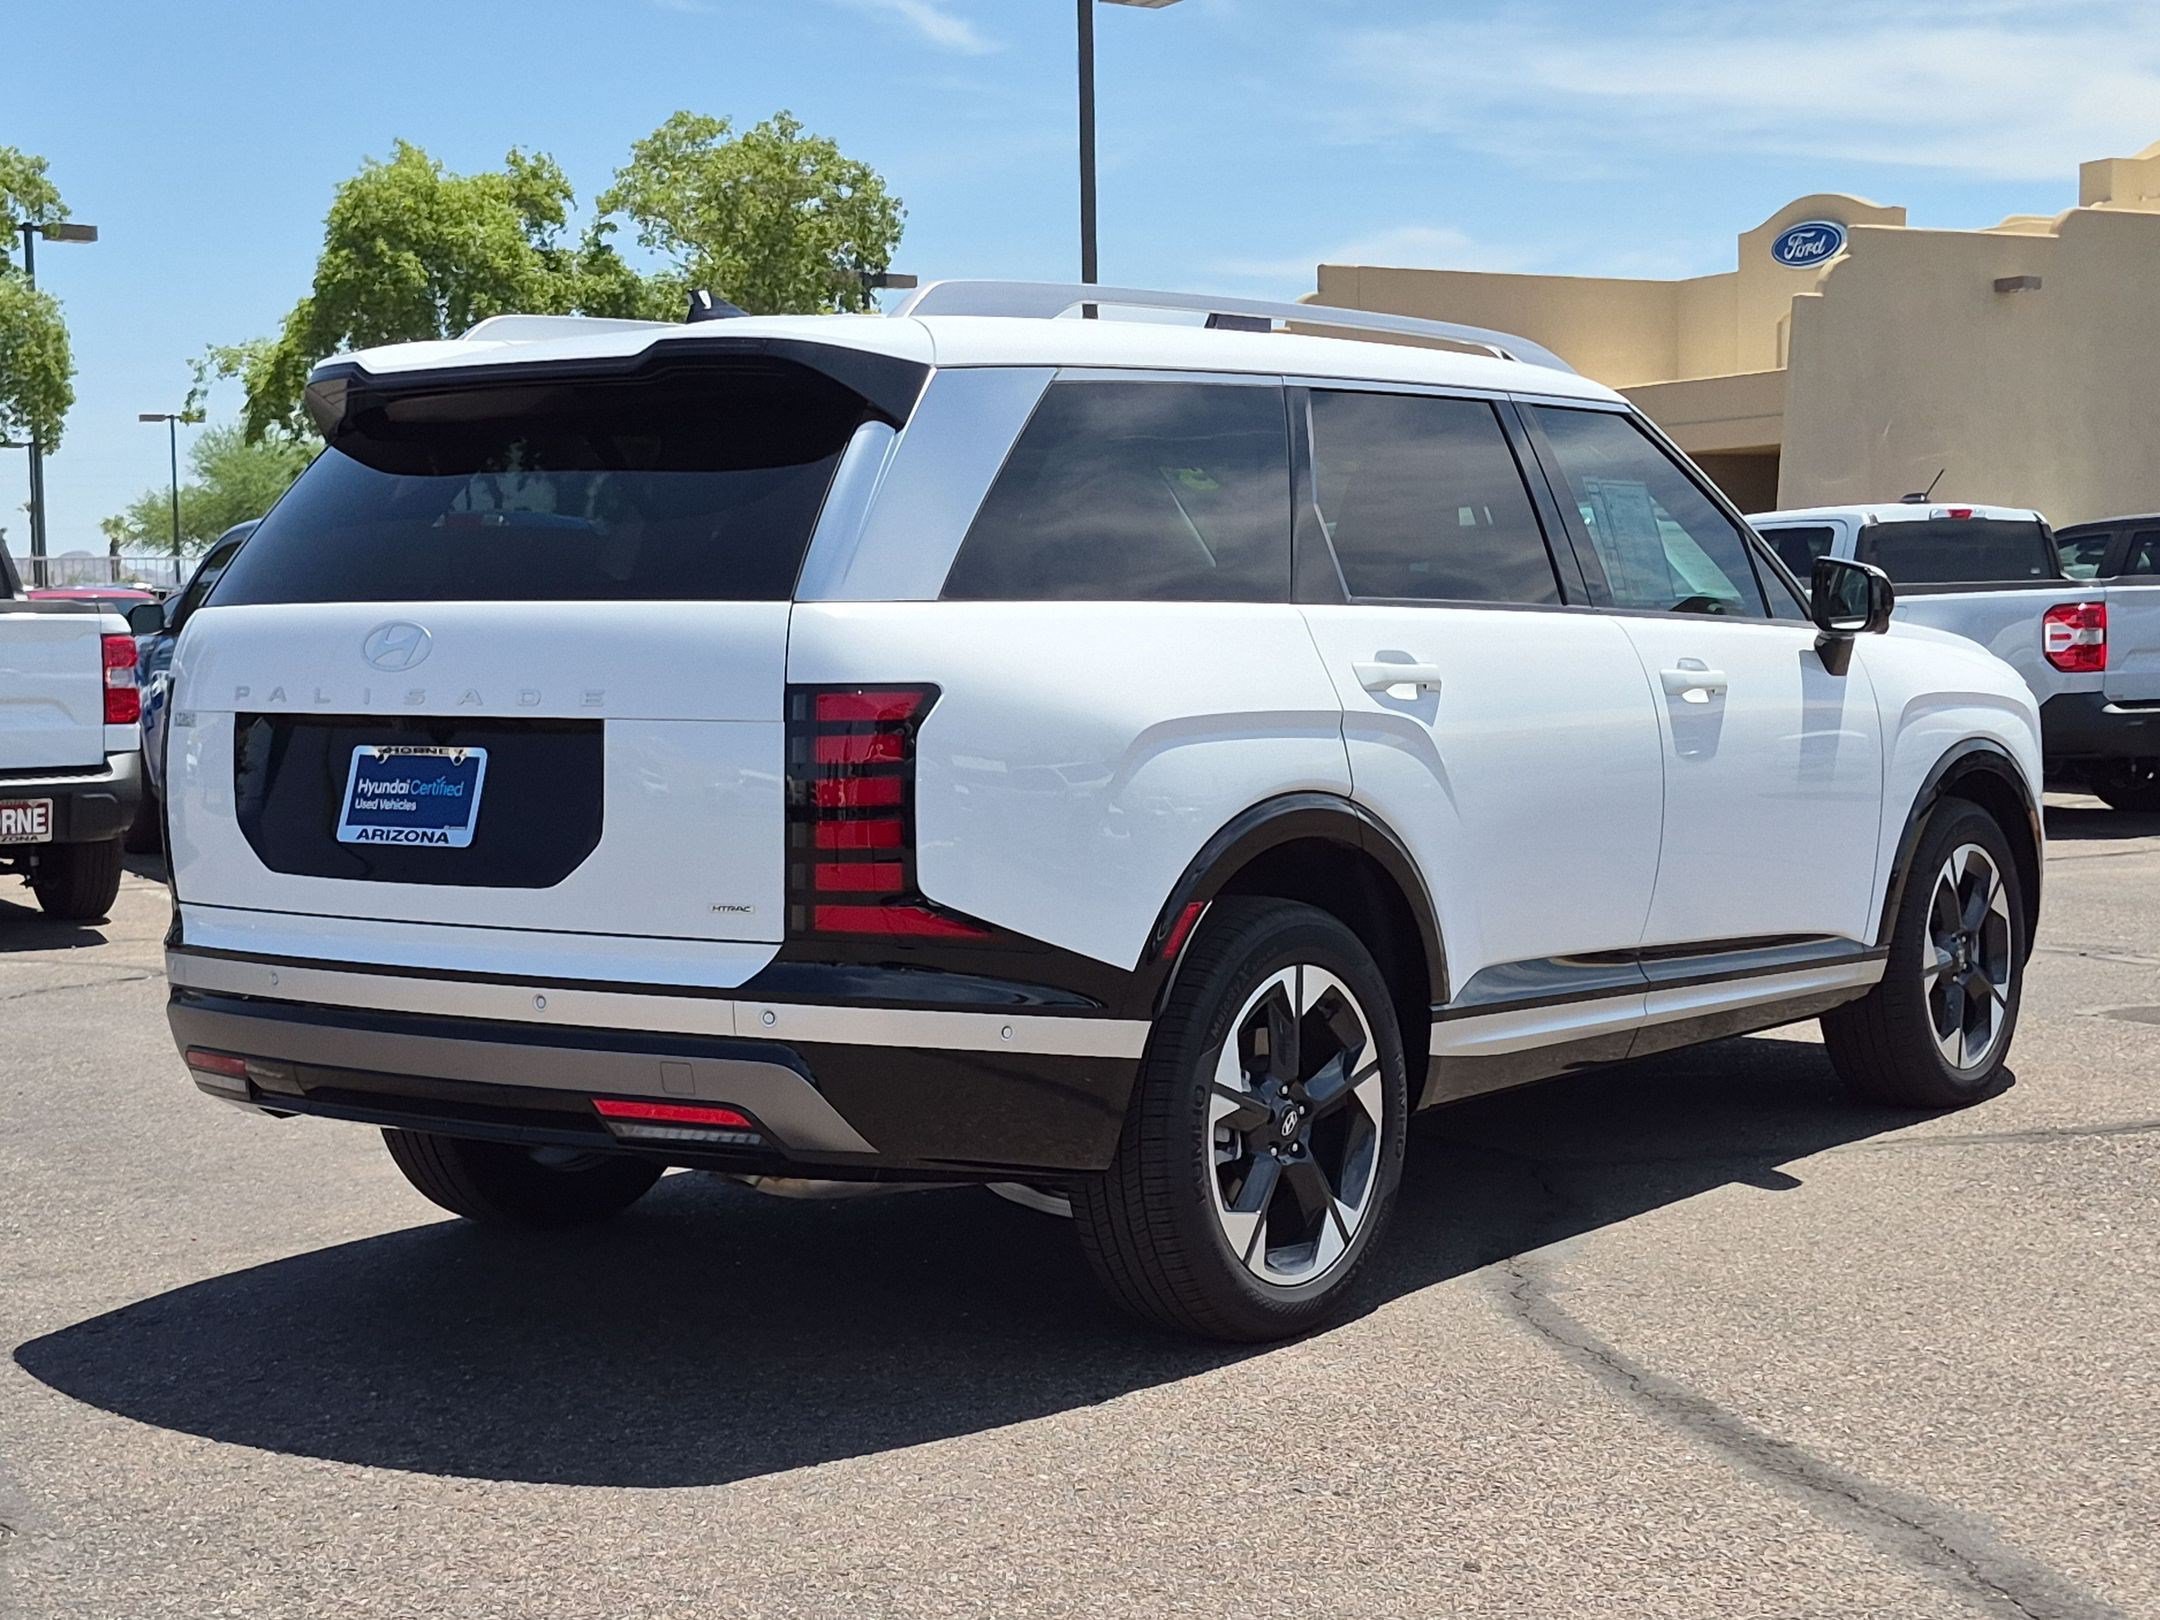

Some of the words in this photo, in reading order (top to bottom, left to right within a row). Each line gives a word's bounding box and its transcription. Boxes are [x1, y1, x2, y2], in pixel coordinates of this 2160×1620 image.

[1784, 231, 1827, 260] Ford
[234, 686, 605, 706] PALISADE
[357, 778, 411, 797] Hyundai
[411, 778, 465, 796] Certified
[355, 798, 378, 810] Used
[380, 799, 416, 811] Vehicles
[0, 808, 47, 834] RNE
[355, 828, 450, 844] ARIZONA
[1191, 1084, 1206, 1206] KUMHO
